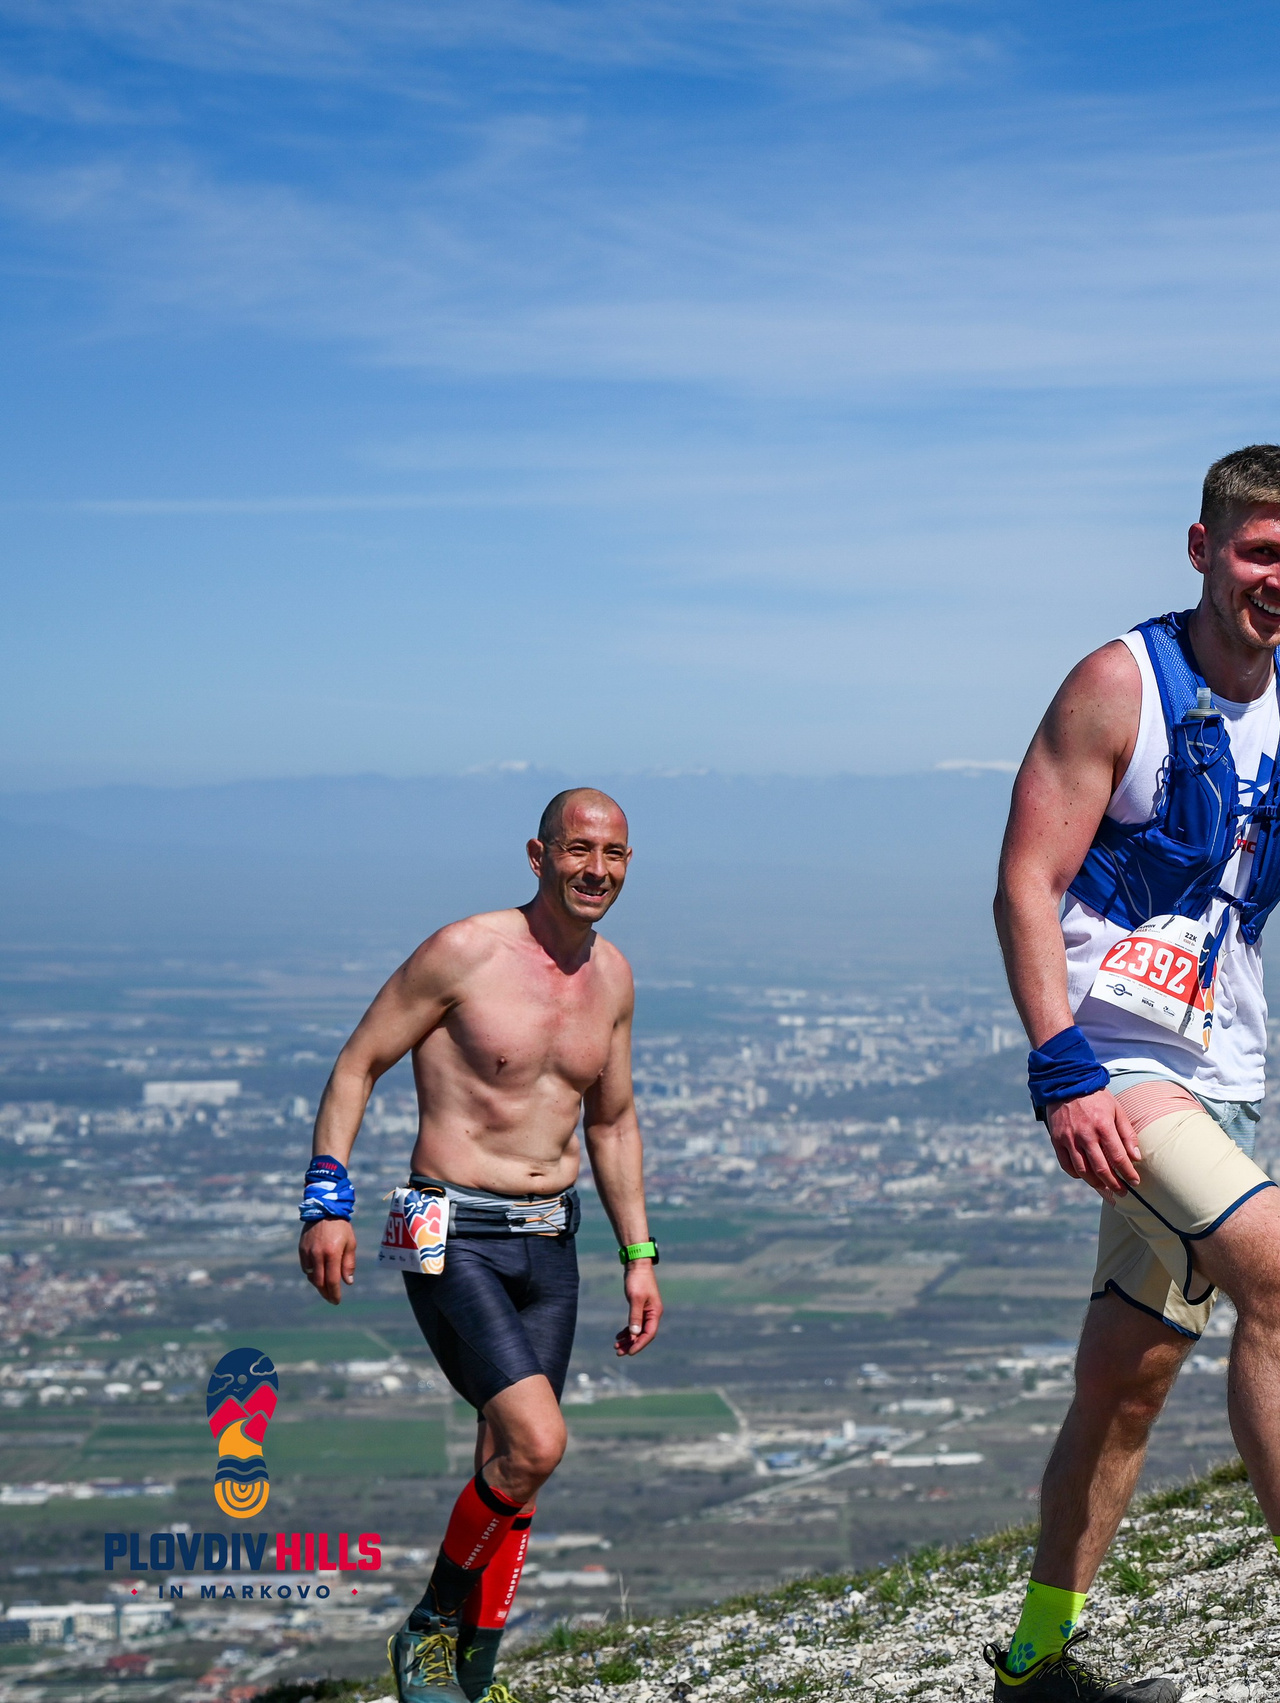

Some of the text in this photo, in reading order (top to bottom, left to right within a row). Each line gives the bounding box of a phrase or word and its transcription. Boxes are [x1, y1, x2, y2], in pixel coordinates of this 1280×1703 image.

[1105, 940, 1193, 995] 2392
[382, 1215, 404, 1246] 97
[461, 1517, 500, 1571] COMPRE SPORT
[504, 1567, 520, 1605] COMPRE
